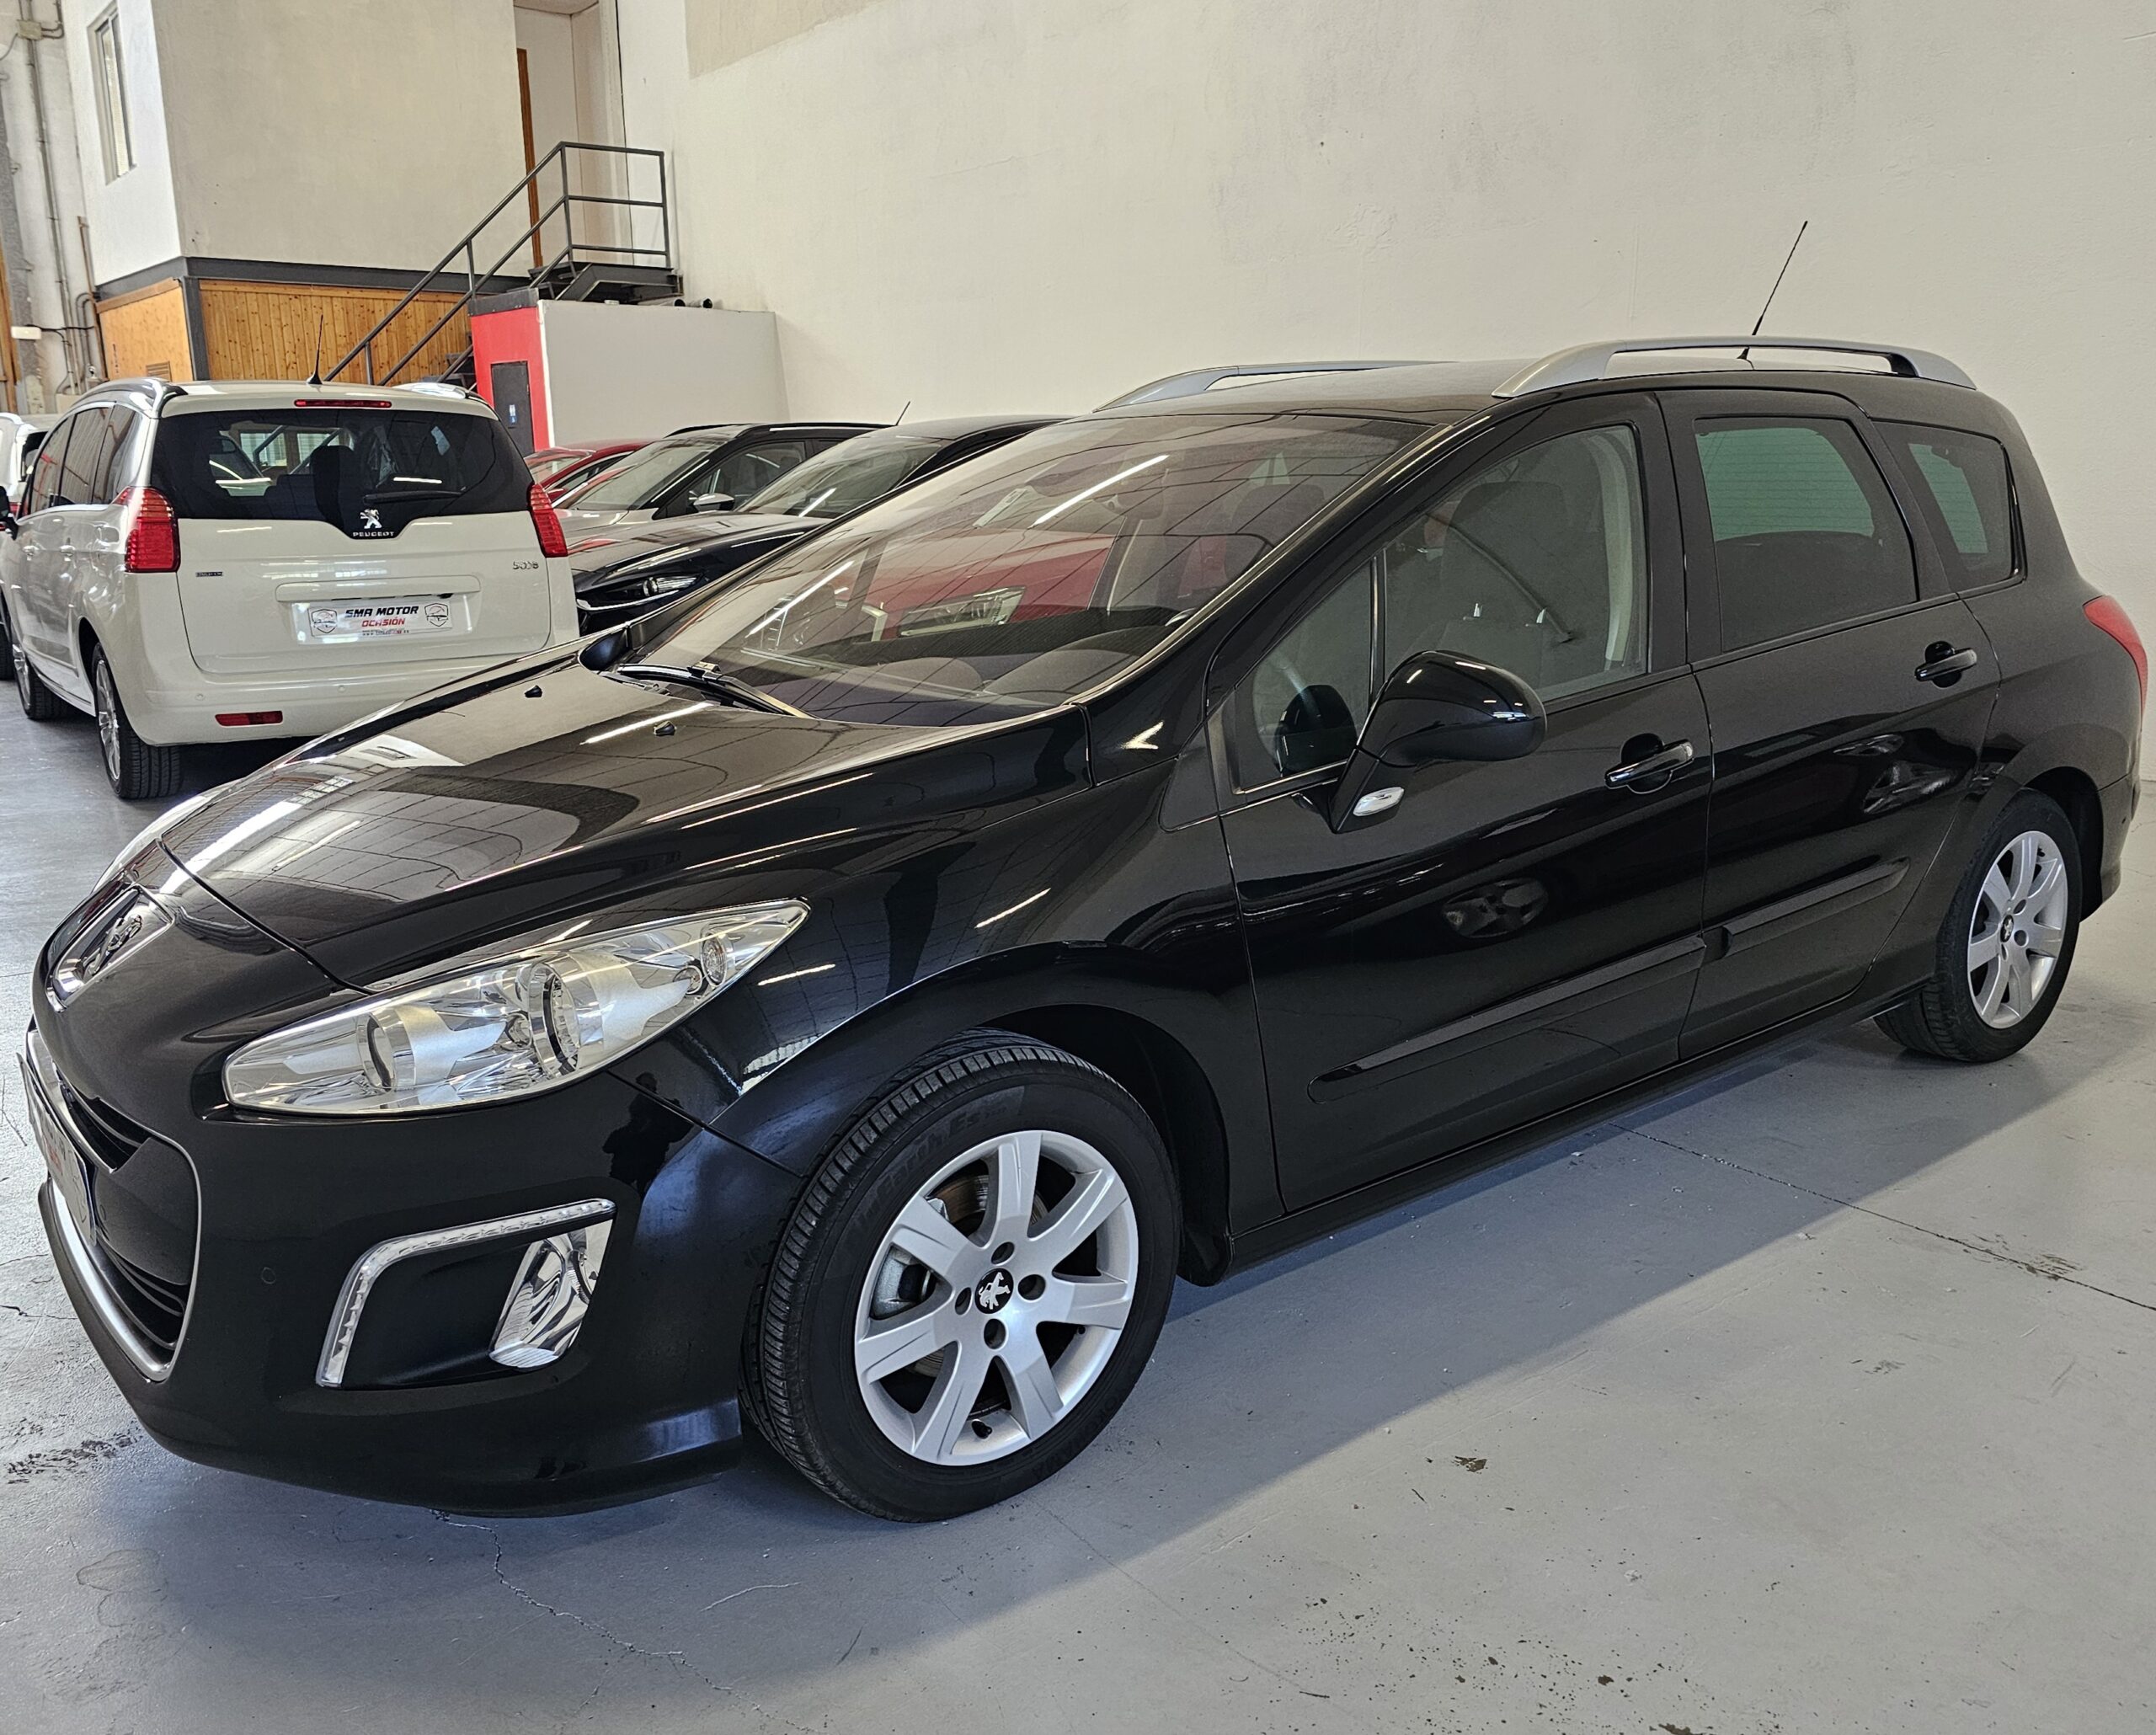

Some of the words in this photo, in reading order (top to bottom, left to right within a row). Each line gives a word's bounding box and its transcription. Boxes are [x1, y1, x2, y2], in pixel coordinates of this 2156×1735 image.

[344, 609, 373, 618] SMA
[376, 606, 419, 617] MOTOR
[361, 617, 405, 627] OCASIÓN
